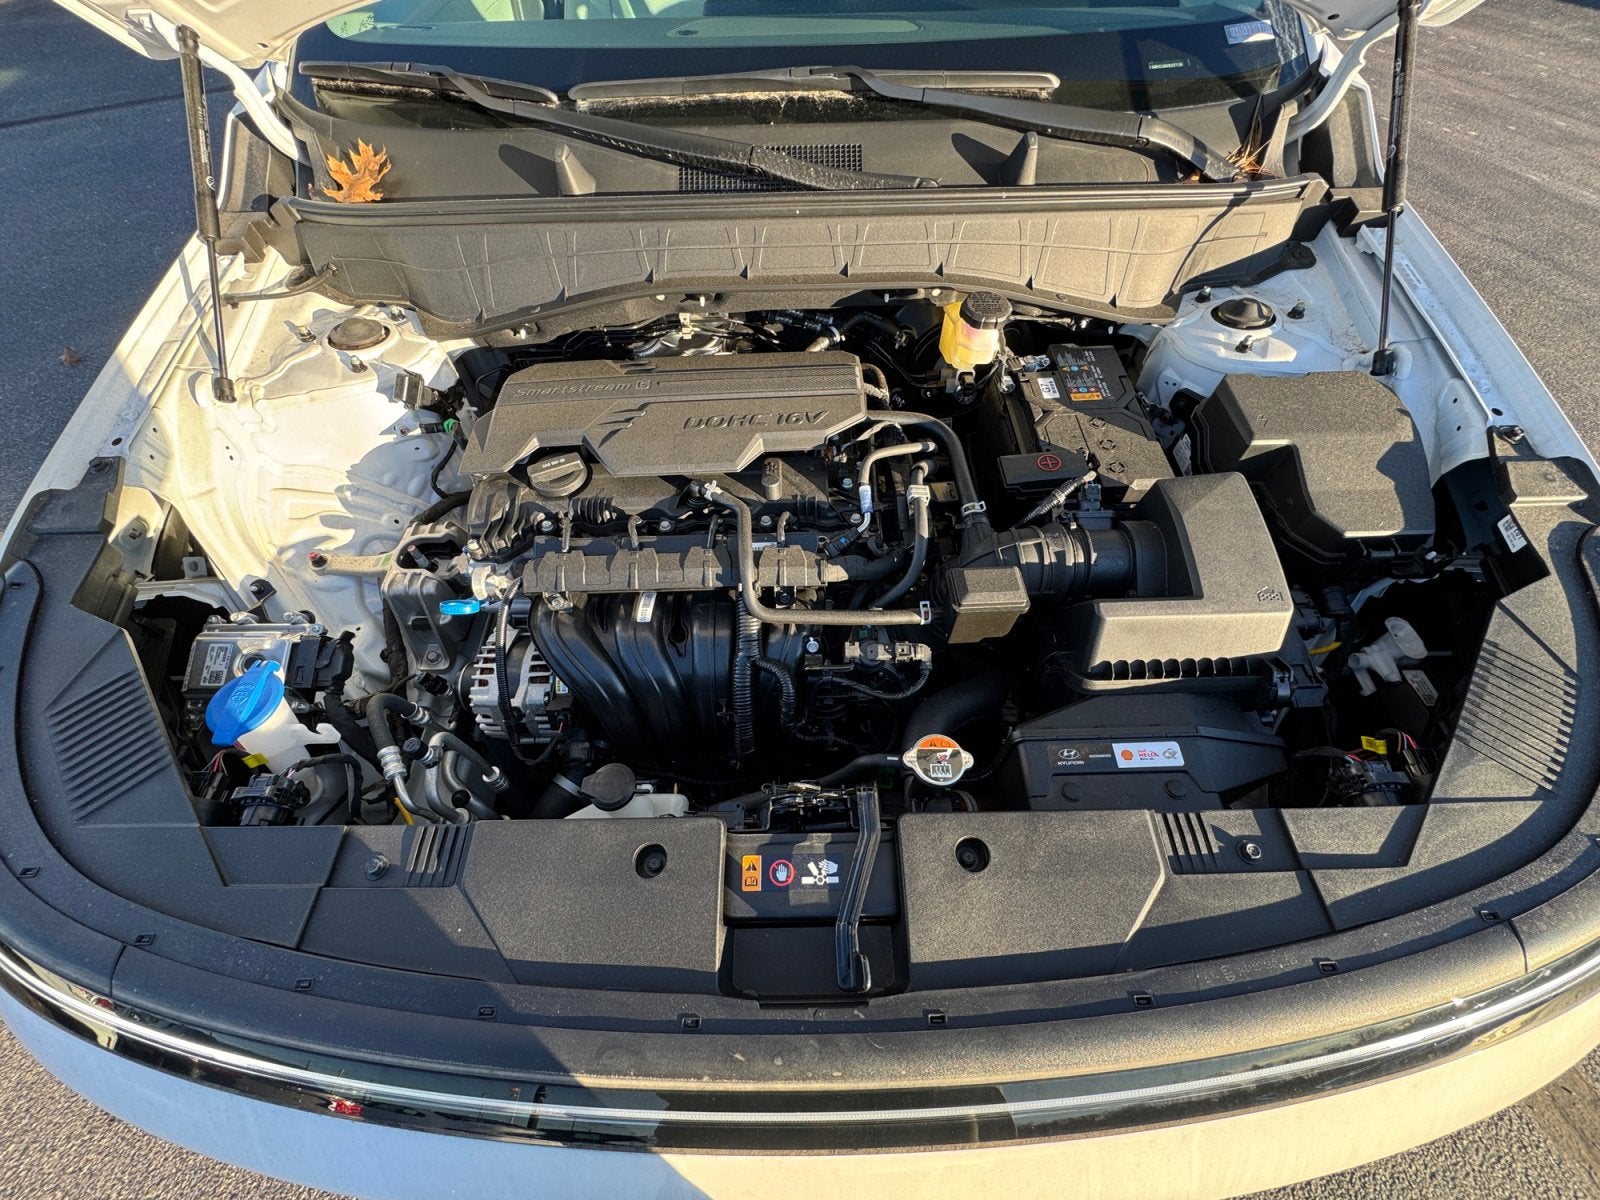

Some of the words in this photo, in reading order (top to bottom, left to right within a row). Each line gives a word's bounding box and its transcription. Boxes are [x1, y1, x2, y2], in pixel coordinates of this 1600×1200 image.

[512, 383, 633, 398] Smartstream
[683, 413, 773, 430] DOHC
[776, 410, 830, 425] 16V
